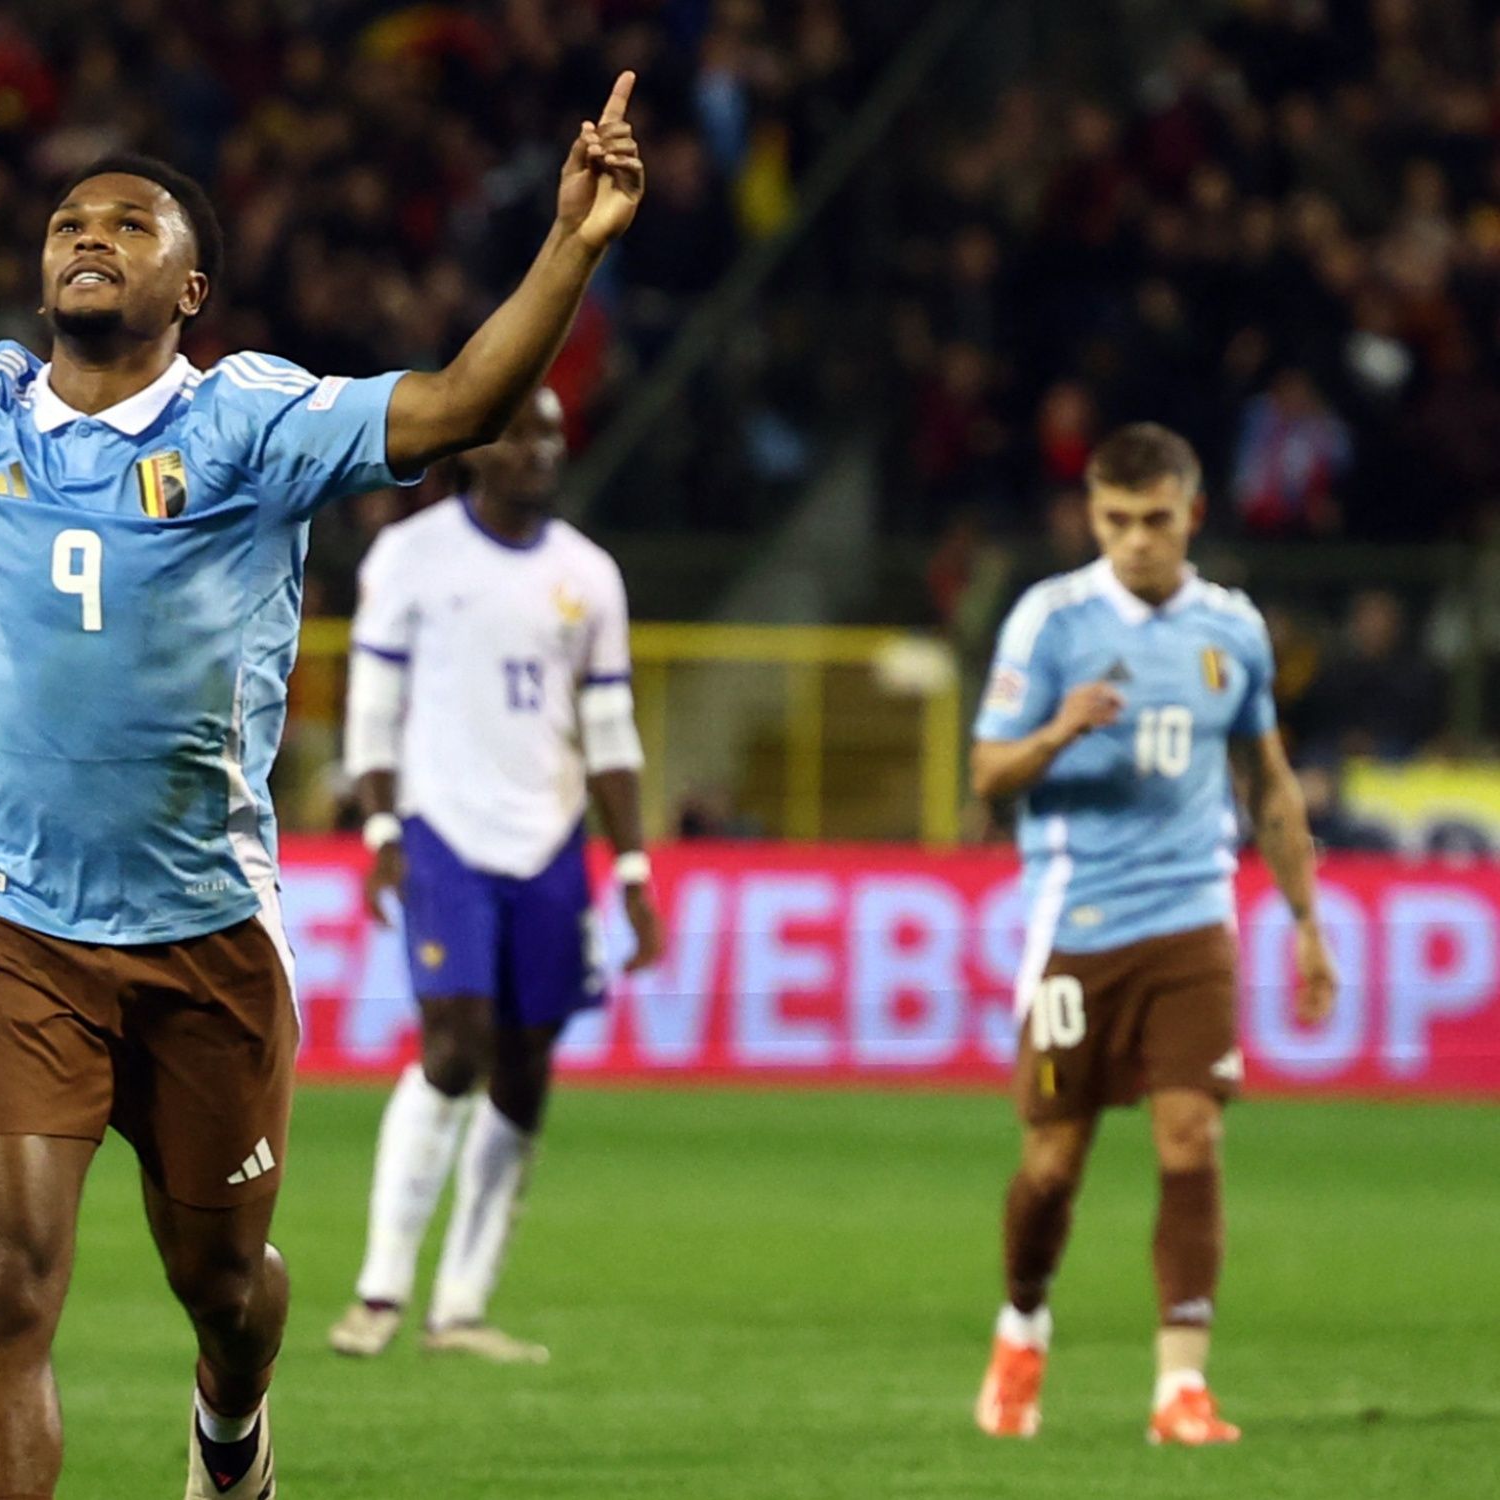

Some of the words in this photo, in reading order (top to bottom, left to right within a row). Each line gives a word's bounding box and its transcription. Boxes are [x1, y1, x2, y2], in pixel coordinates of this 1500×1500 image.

[51, 527, 102, 631] 9
[1133, 704, 1193, 778] 10
[1030, 975, 1087, 1050] 10
